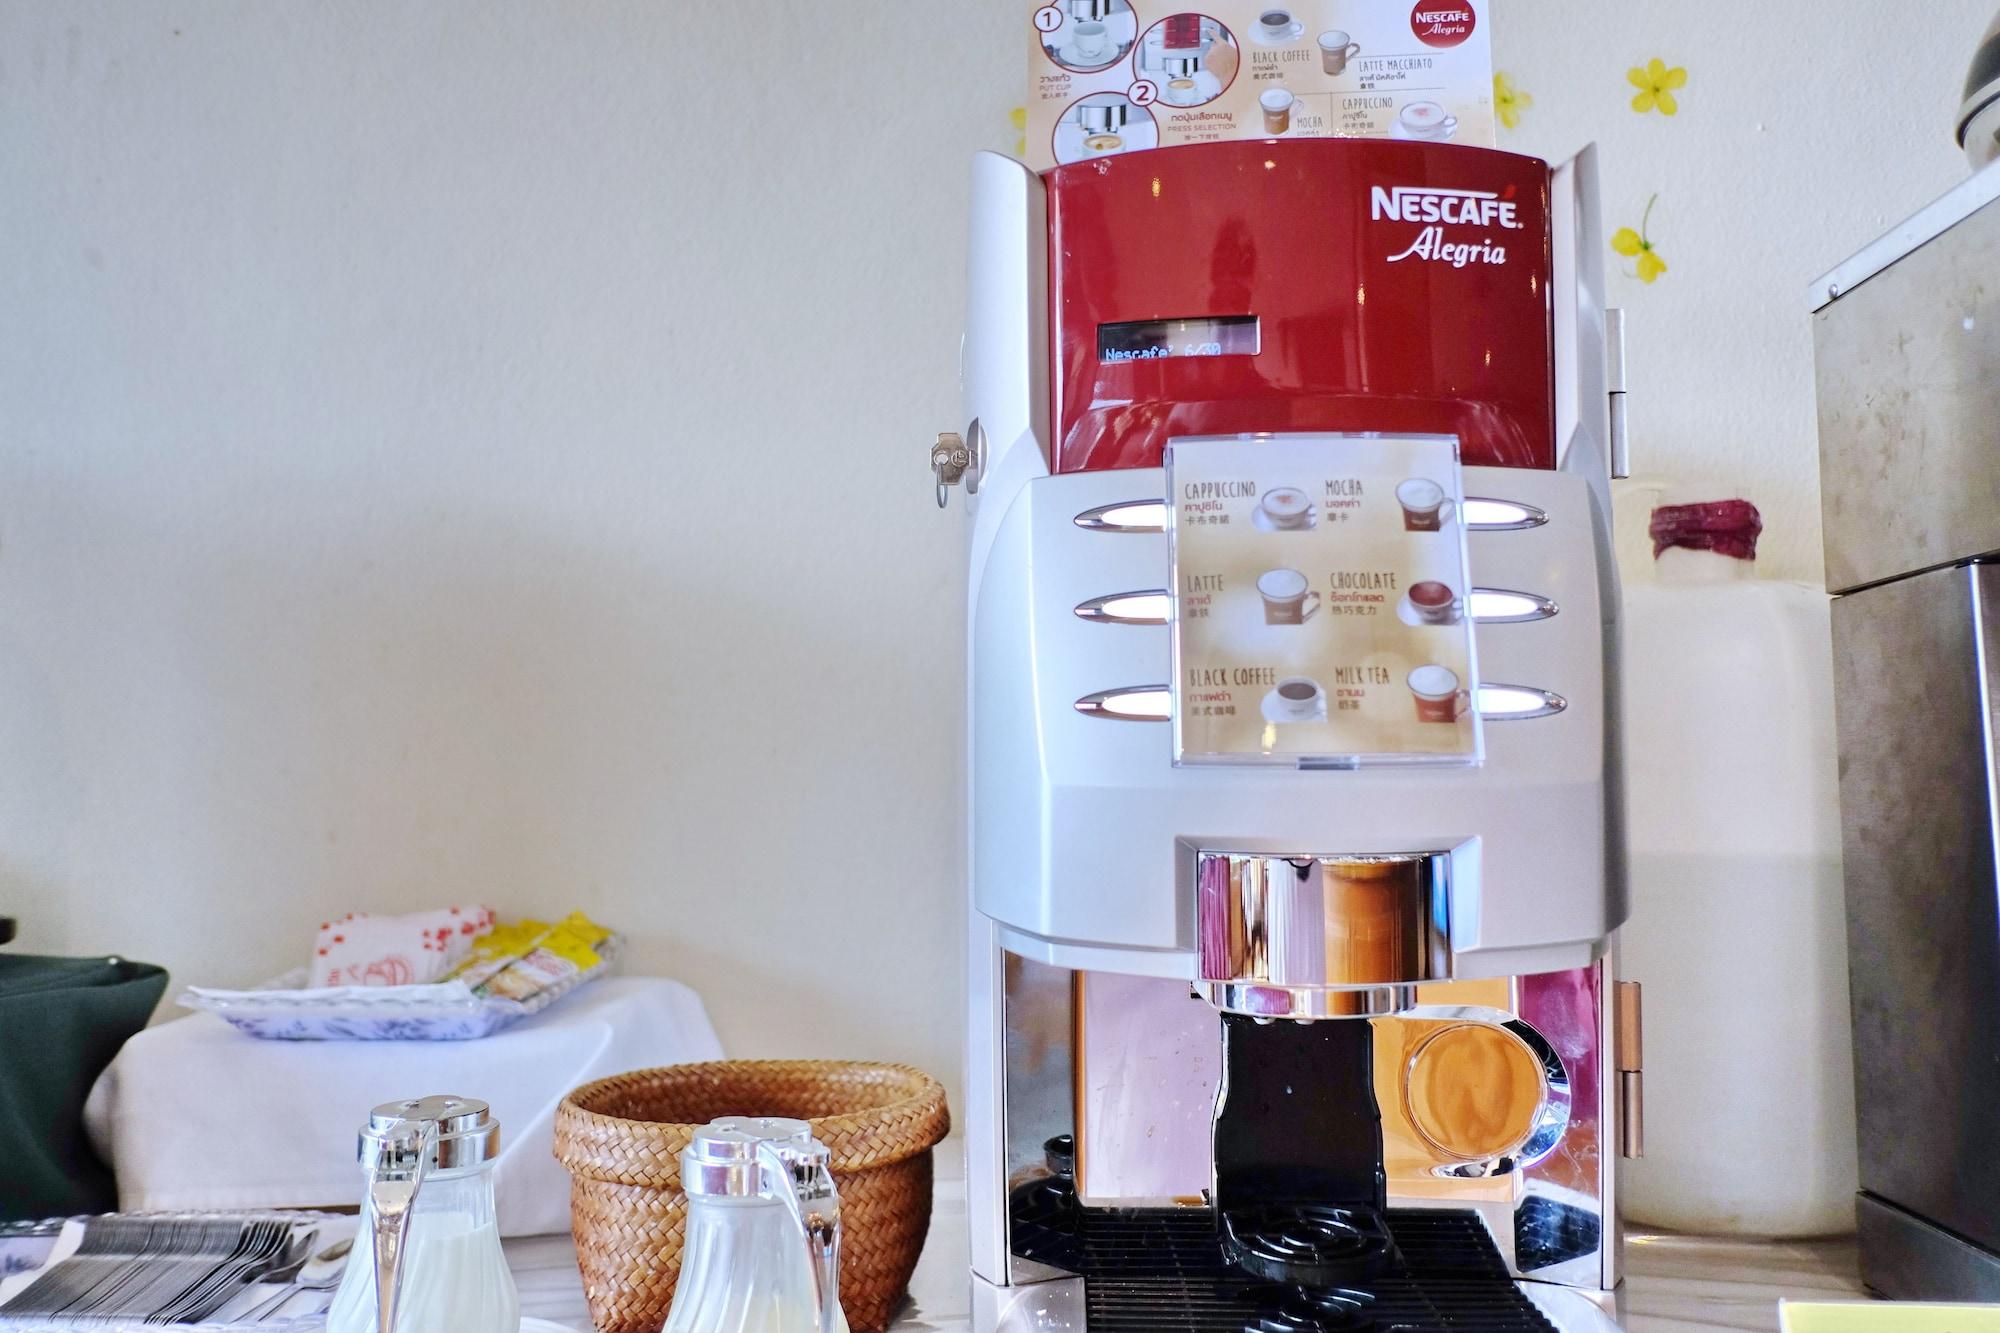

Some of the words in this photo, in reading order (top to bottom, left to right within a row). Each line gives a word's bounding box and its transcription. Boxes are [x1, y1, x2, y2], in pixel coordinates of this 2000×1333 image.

[1042, 12, 1051, 27] 1
[1421, 22, 1465, 36] Alegria
[1252, 51, 1277, 63] BLACK
[1281, 49, 1310, 62] COFFEE
[1359, 60, 1383, 72] LATTE
[1387, 58, 1433, 71] MACCHIATO
[1136, 85, 1149, 101] 2
[1342, 97, 1393, 110] CAPPUCCINO
[1296, 116, 1323, 128] MOCHA
[1386, 226, 1507, 268] Alegria
[1184, 481, 1256, 500] CAPPUCCINO
[1325, 479, 1364, 496] MOCHA
[1187, 574, 1224, 593] LATTE
[1330, 572, 1397, 590] CHOCOLATE
[1190, 668, 1228, 688] BLACK
[1233, 667, 1276, 686] COFFEE
[1335, 667, 1363, 685] MILK
[1368, 666, 1390, 685] TEA
